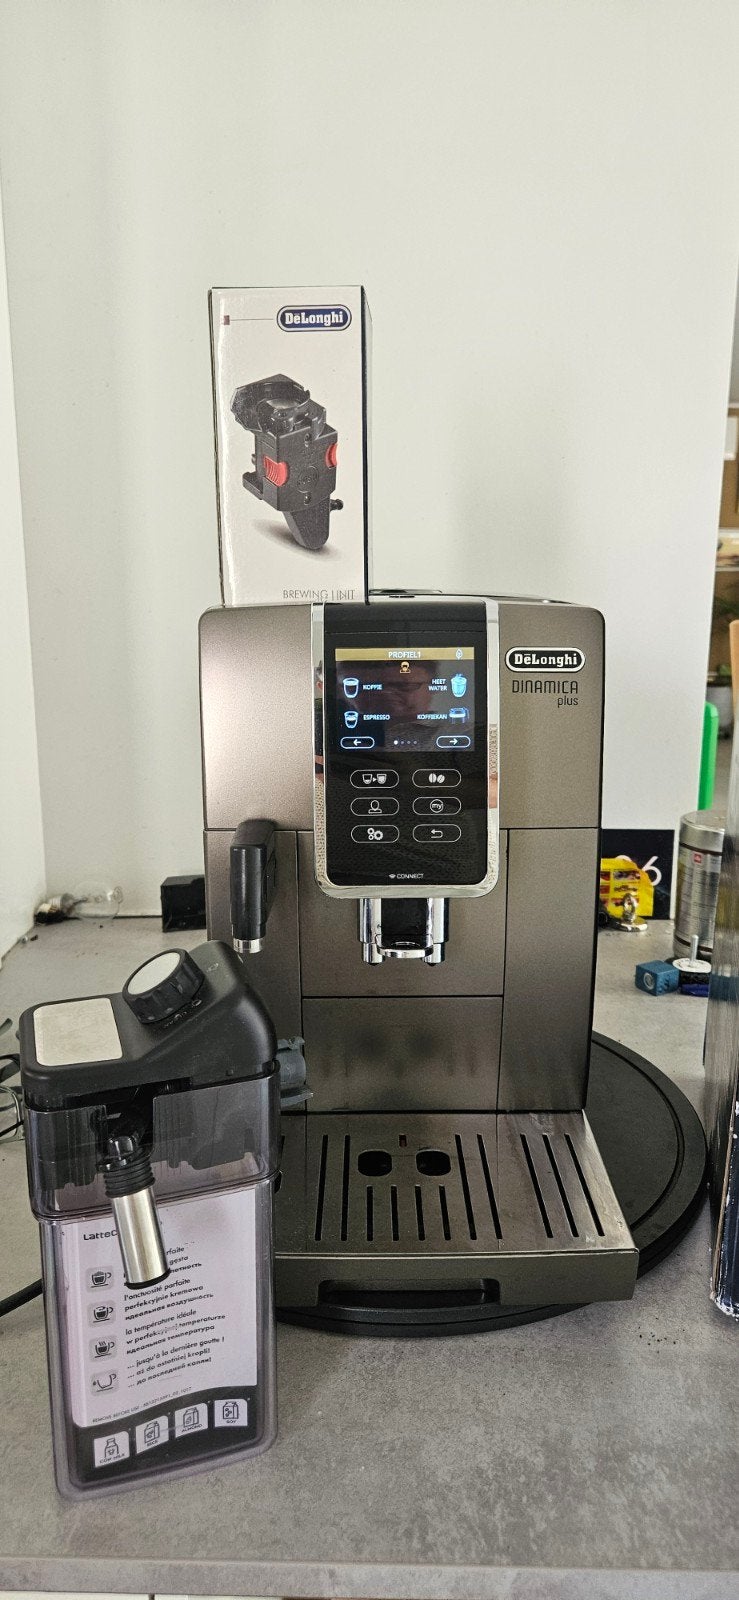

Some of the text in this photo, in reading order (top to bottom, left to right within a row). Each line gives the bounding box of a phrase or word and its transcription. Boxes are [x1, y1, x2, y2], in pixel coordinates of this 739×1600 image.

[283, 589, 328, 600] BREWING
[512, 680, 578, 694] DINAMICA
[557, 695, 579, 708] plus
[83, 1229, 118, 1241] LatteC
[166, 1246, 185, 1255] rfaite
[164, 1279, 190, 1291] parfaite
[170, 1286, 203, 1297] kremowa
[200, 1337, 220, 1347] goutte
